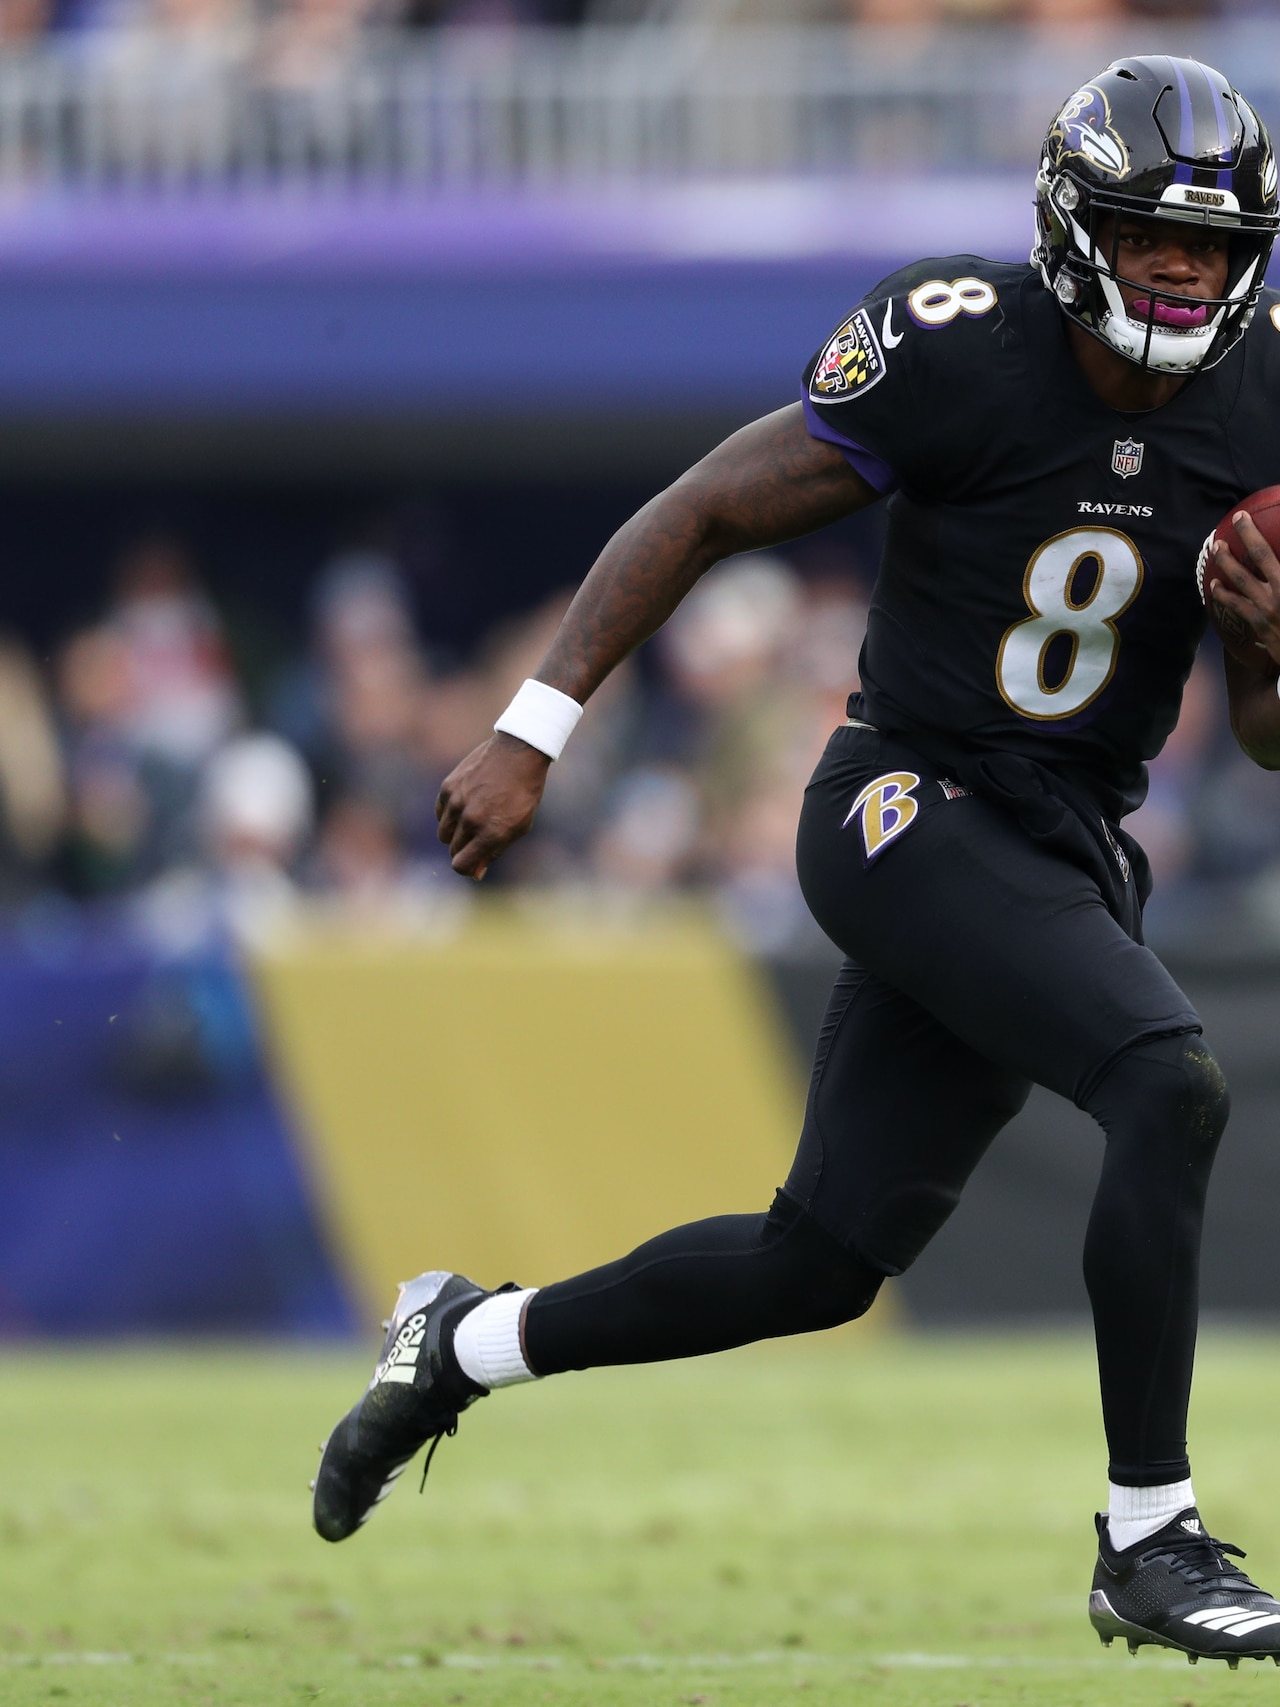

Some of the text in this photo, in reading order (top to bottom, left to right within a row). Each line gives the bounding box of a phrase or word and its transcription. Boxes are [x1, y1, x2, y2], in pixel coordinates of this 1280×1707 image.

[1058, 91, 1094, 122] B
[1184, 189, 1225, 207] RAVENS
[907, 276, 998, 327] 8
[823, 325, 860, 393] B R
[854, 314, 879, 371] RAVENS
[1116, 455, 1138, 472] NFL
[1077, 501, 1154, 518] RAVENS
[995, 524, 1146, 722] 8
[841, 770, 921, 865] B
